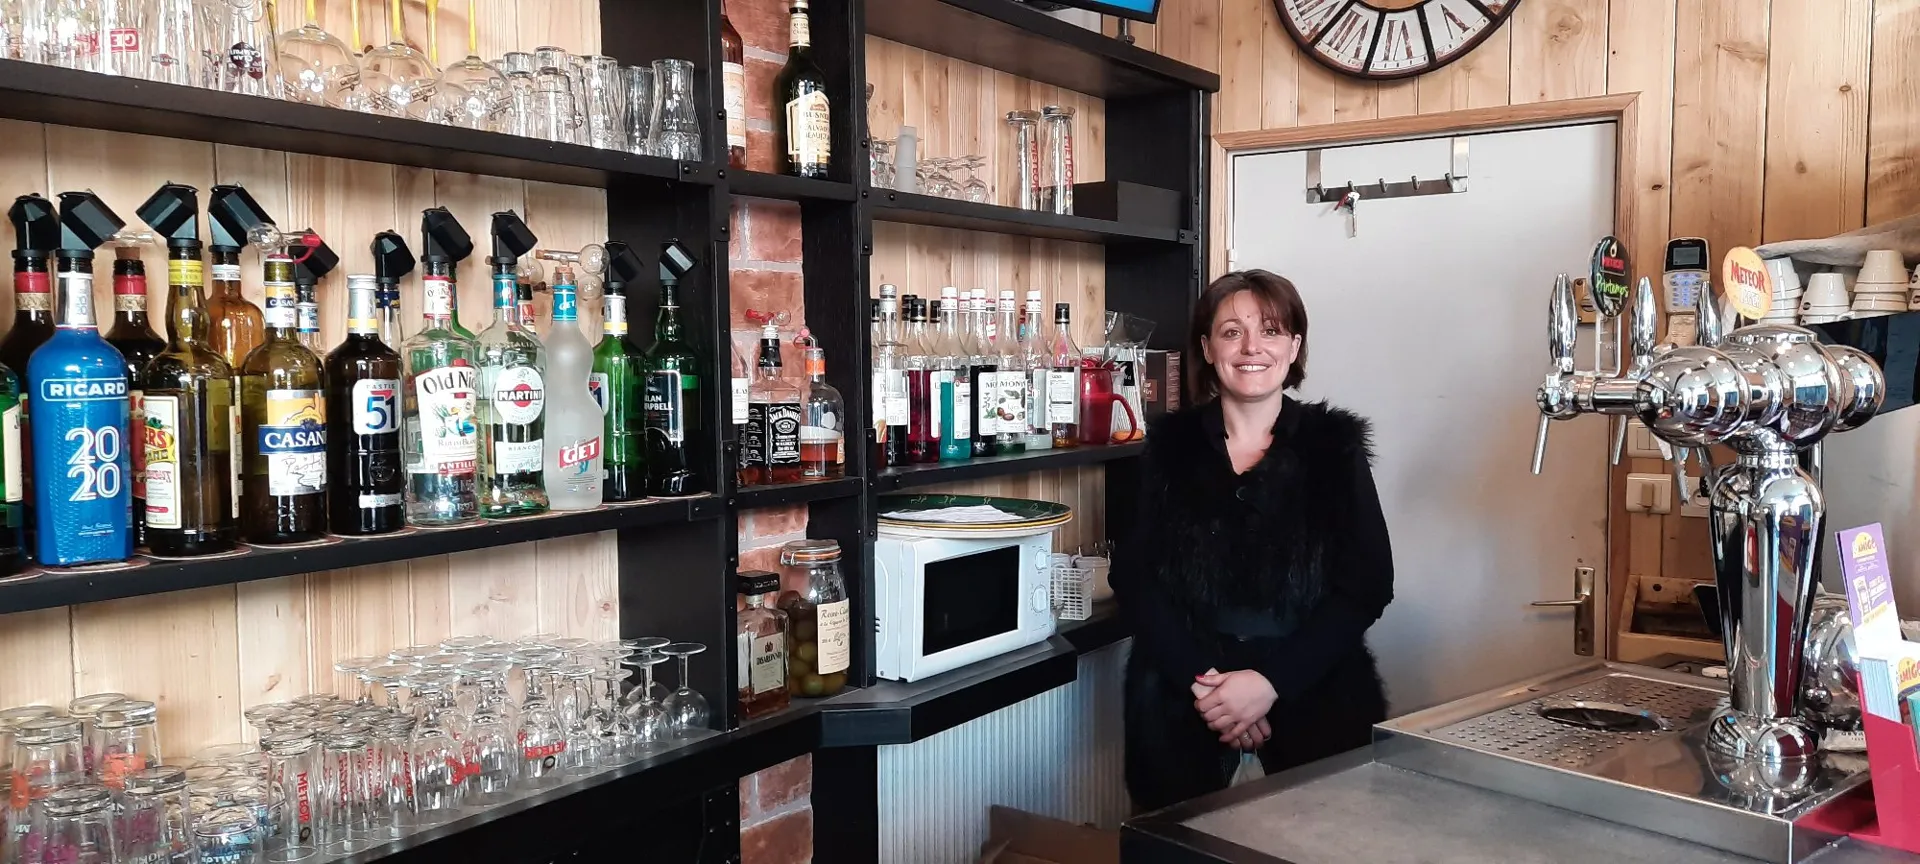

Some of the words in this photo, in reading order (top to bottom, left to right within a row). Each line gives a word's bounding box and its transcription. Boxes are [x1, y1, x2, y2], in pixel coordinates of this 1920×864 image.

[1731, 259, 1767, 294] METEOR
[50, 383, 126, 397] RICARD
[423, 372, 454, 395] Old
[498, 390, 541, 401] MARTINI
[366, 395, 396, 430] 51
[64, 426, 120, 465] 20
[562, 440, 598, 465] GET
[67, 463, 121, 501] 20
[296, 771, 313, 824] METEOR
